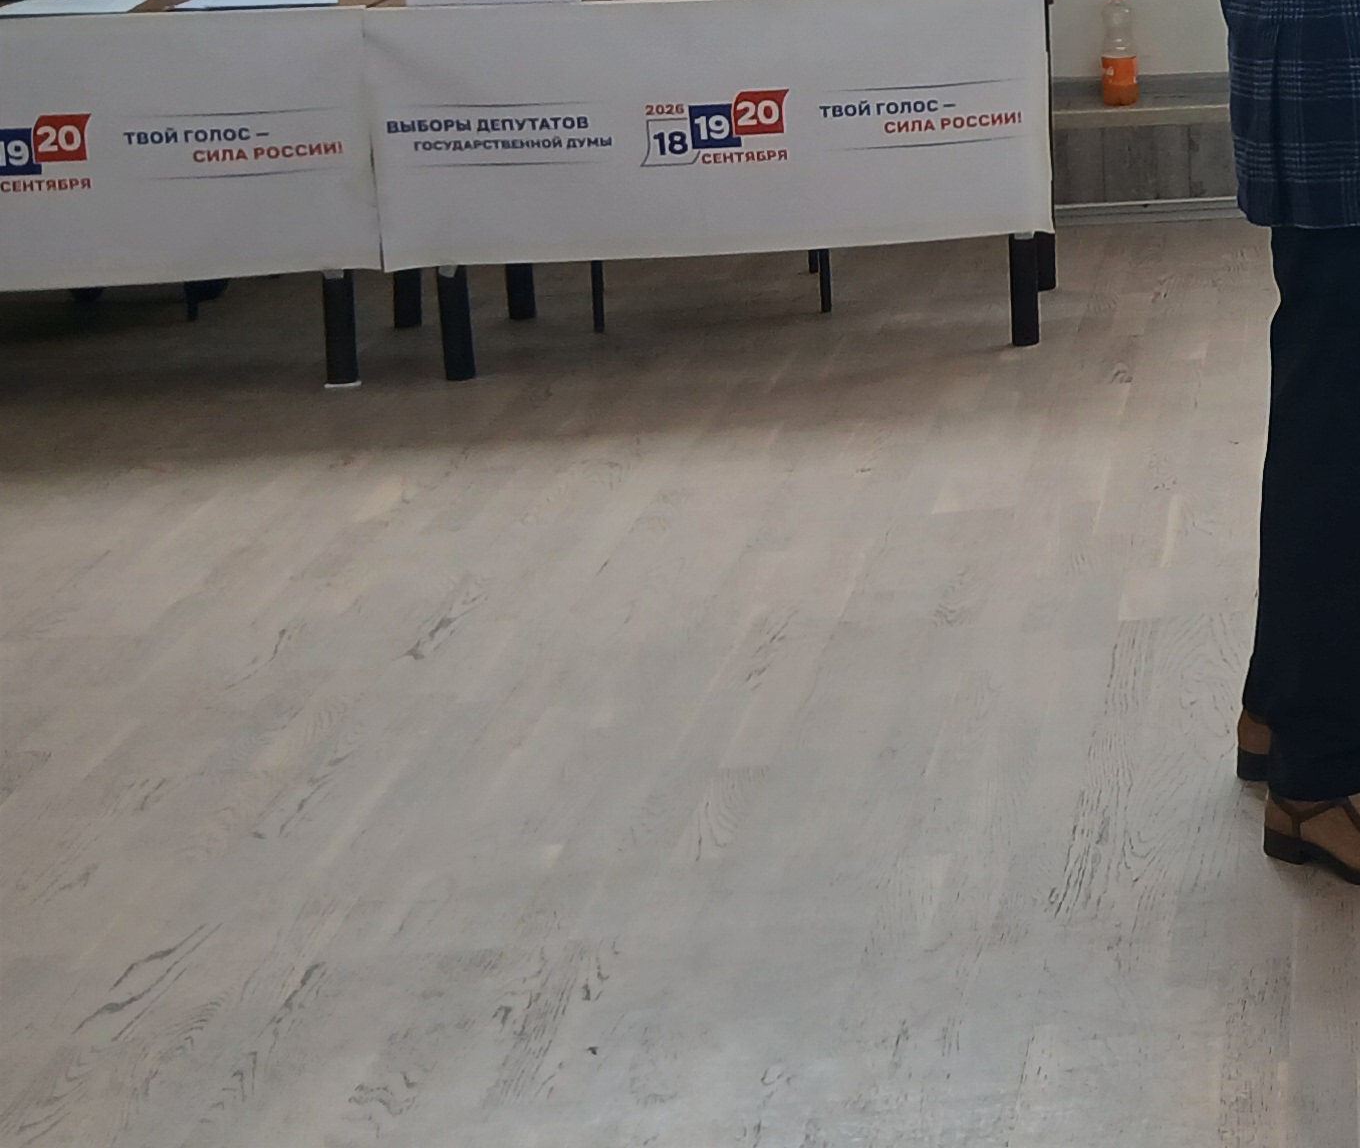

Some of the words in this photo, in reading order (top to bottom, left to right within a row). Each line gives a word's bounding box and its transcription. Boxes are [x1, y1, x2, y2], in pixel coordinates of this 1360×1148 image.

[645, 104, 686, 117] 2026
[819, 100, 871, 118] ТВОЙ
[876, 99, 939, 116] ГОЛОС
[386, 118, 472, 134] ВЫБОРЫ
[476, 115, 589, 133] ДЕПУТАТОВ
[653, 130, 689, 156] 18
[694, 115, 731, 142] 19
[736, 100, 780, 127] 20
[884, 118, 936, 134] СИЛА
[941, 111, 1023, 131] РОССИИ!
[36, 125, 81, 153] 20
[123, 127, 179, 145] ТВОЙ
[184, 127, 251, 144] ГОЛОС
[413, 135, 563, 152] ГОСУДАРСТВЕННОЙ
[565, 135, 613, 150] ДУМЫ
[192, 148, 248, 163] СИЛА
[253, 141, 344, 161] РОССИИ!
[701, 150, 788, 166] СЕНТЯБРЯ
[0, 177, 92, 193] СЕНТЯБРЯ
